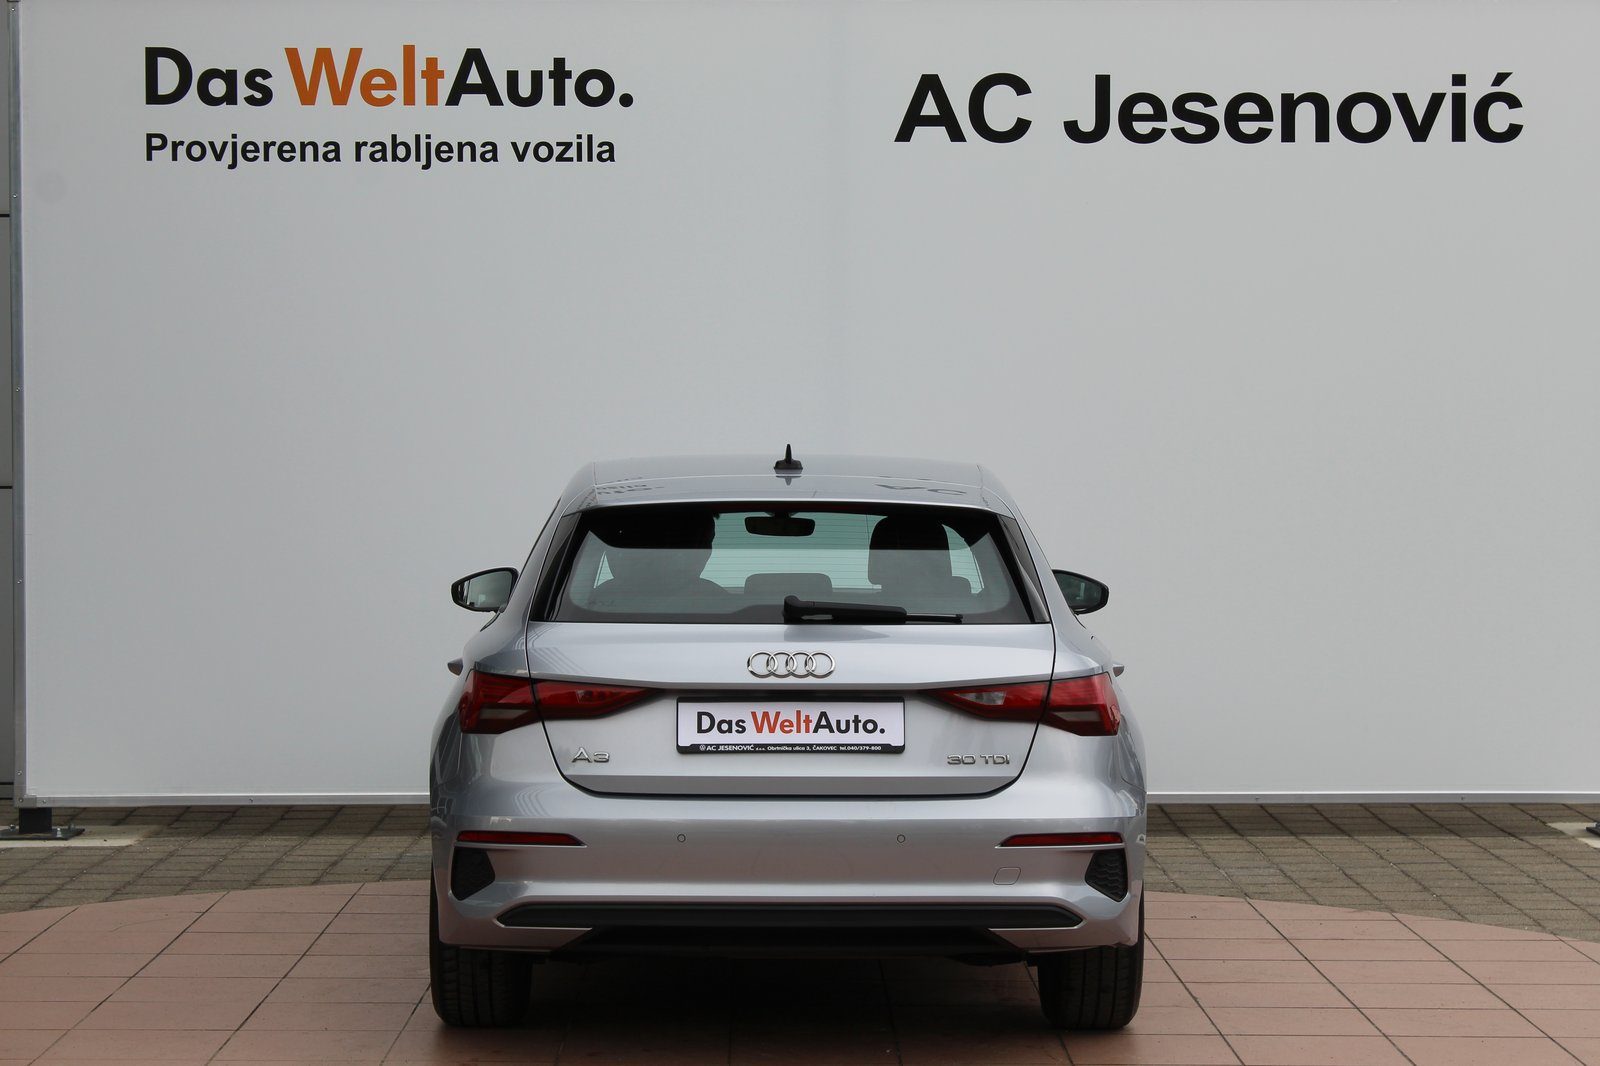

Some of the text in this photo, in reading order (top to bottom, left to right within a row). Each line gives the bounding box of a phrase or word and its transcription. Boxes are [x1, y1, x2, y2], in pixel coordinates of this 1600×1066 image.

[145, 45, 633, 107] Das WeltAuto.
[894, 72, 1524, 144] AC Jesenović
[146, 133, 616, 170] Provjerena rabljena vozila
[697, 710, 886, 734] Das WeltAuto.
[571, 747, 610, 763] A3
[947, 754, 1010, 765] 30 TDI
